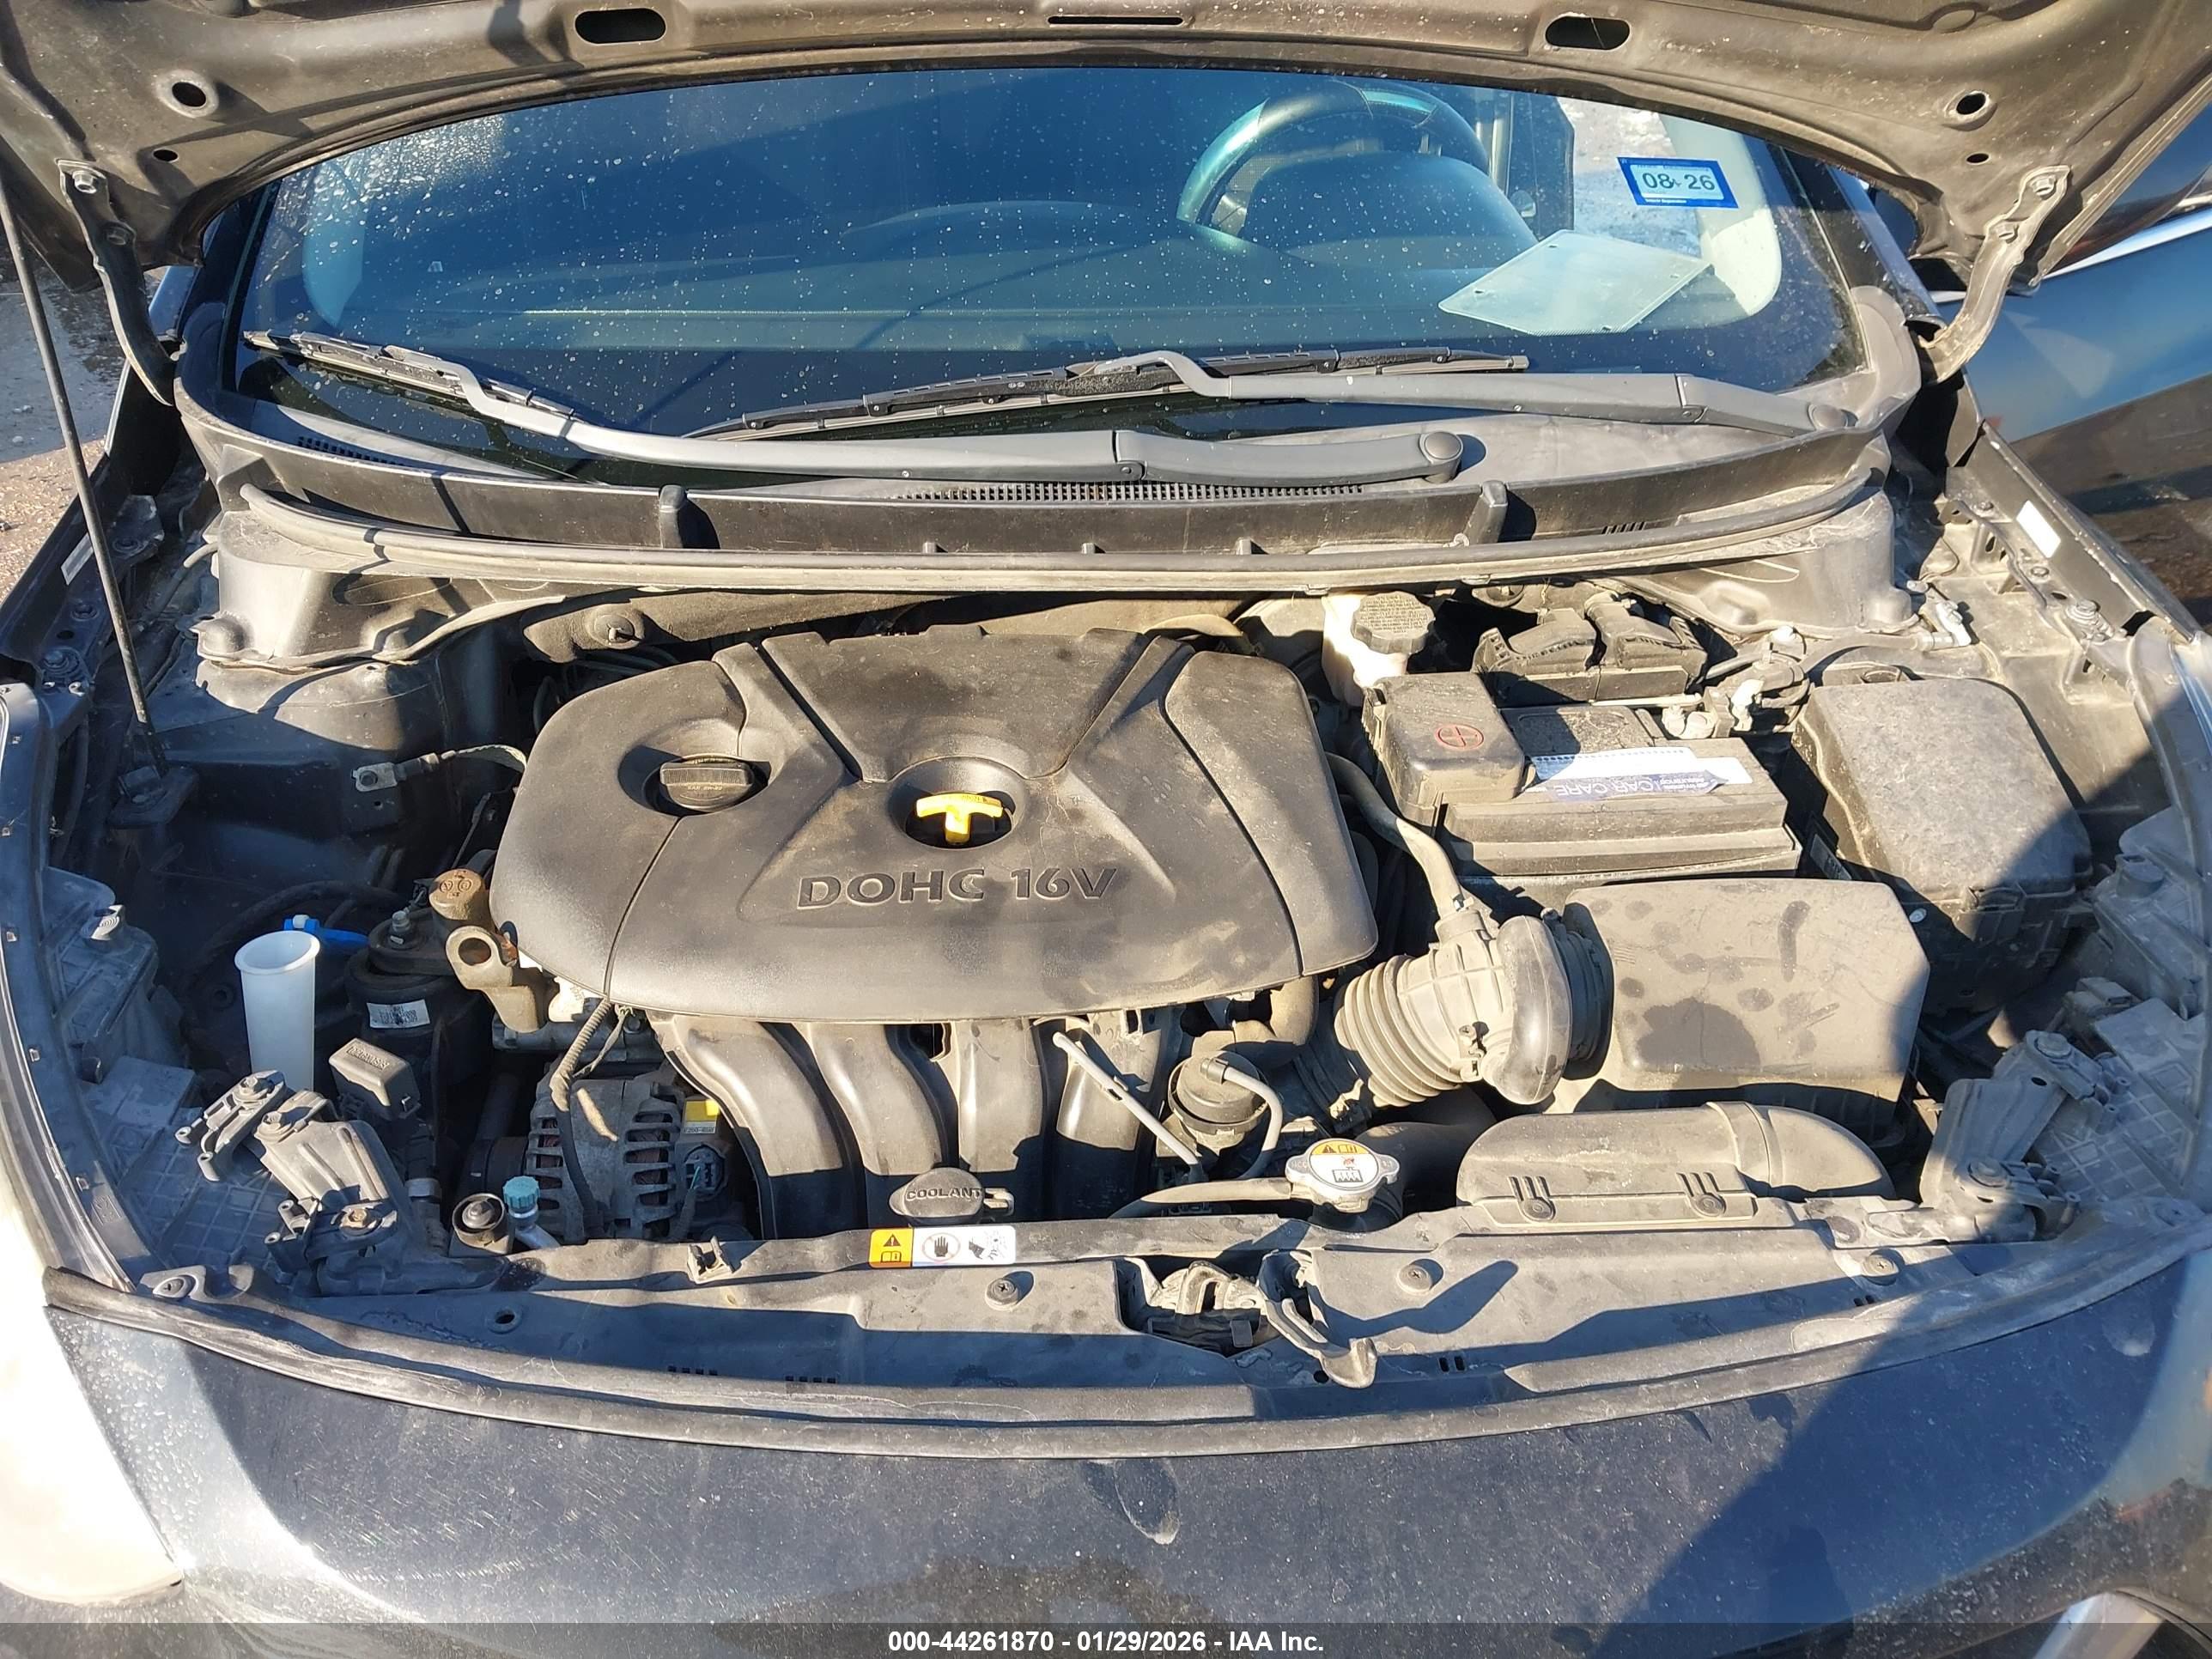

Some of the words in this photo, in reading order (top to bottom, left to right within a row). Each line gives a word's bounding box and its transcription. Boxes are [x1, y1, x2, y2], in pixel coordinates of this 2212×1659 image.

[1642, 173, 1674, 190] 08
[1684, 174, 1716, 191] 26
[1553, 782, 1608, 796] CARE
[1610, 777, 1654, 793] CAR
[797, 867, 986, 909] DOHC
[1011, 867, 1117, 901] 16V
[905, 1188, 982, 1202] COOLANT
